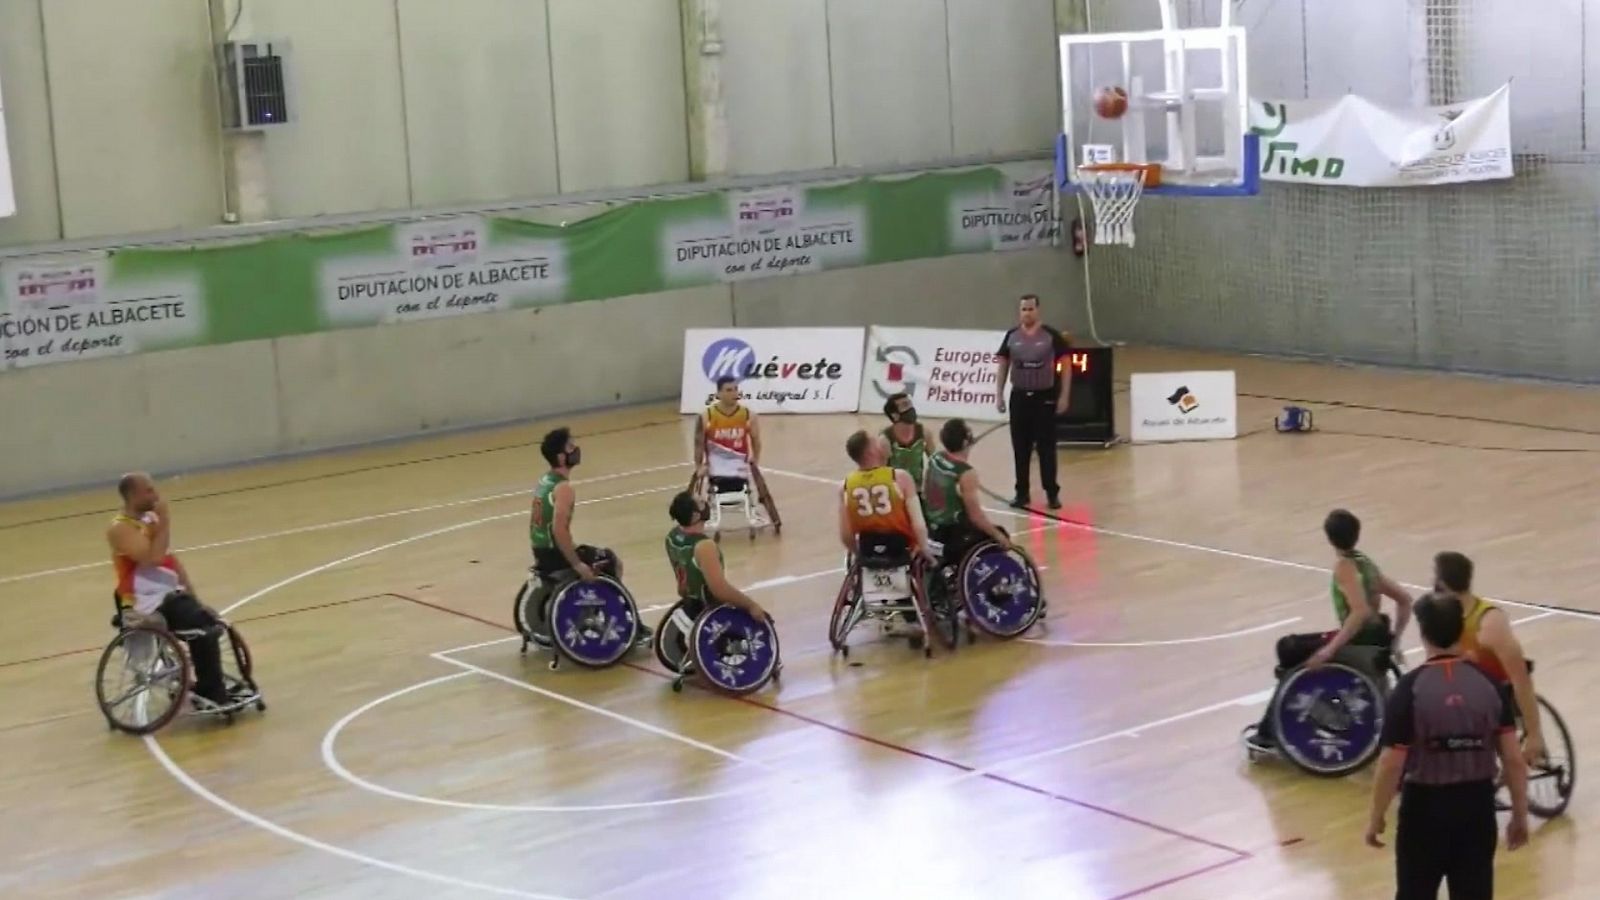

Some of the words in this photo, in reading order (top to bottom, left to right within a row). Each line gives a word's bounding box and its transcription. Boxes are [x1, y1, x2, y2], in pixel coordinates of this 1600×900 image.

[764, 238, 781, 252] DE
[785, 229, 854, 249] ALBACETE
[443, 273, 464, 290] DE
[468, 262, 550, 285] ALBACETE
[725, 263, 746, 274] con
[751, 257, 763, 271] el
[767, 255, 812, 271] deporte
[396, 301, 421, 314] con
[427, 296, 441, 310] el
[446, 290, 499, 311] deporte
[55, 312, 82, 333] DE
[87, 301, 187, 329] ALBACETE
[37, 340, 54, 356] el
[61, 334, 123, 356] deporte
[708, 346, 843, 380] Muévete
[927, 385, 996, 404] Platform
[852, 484, 892, 517] 33
